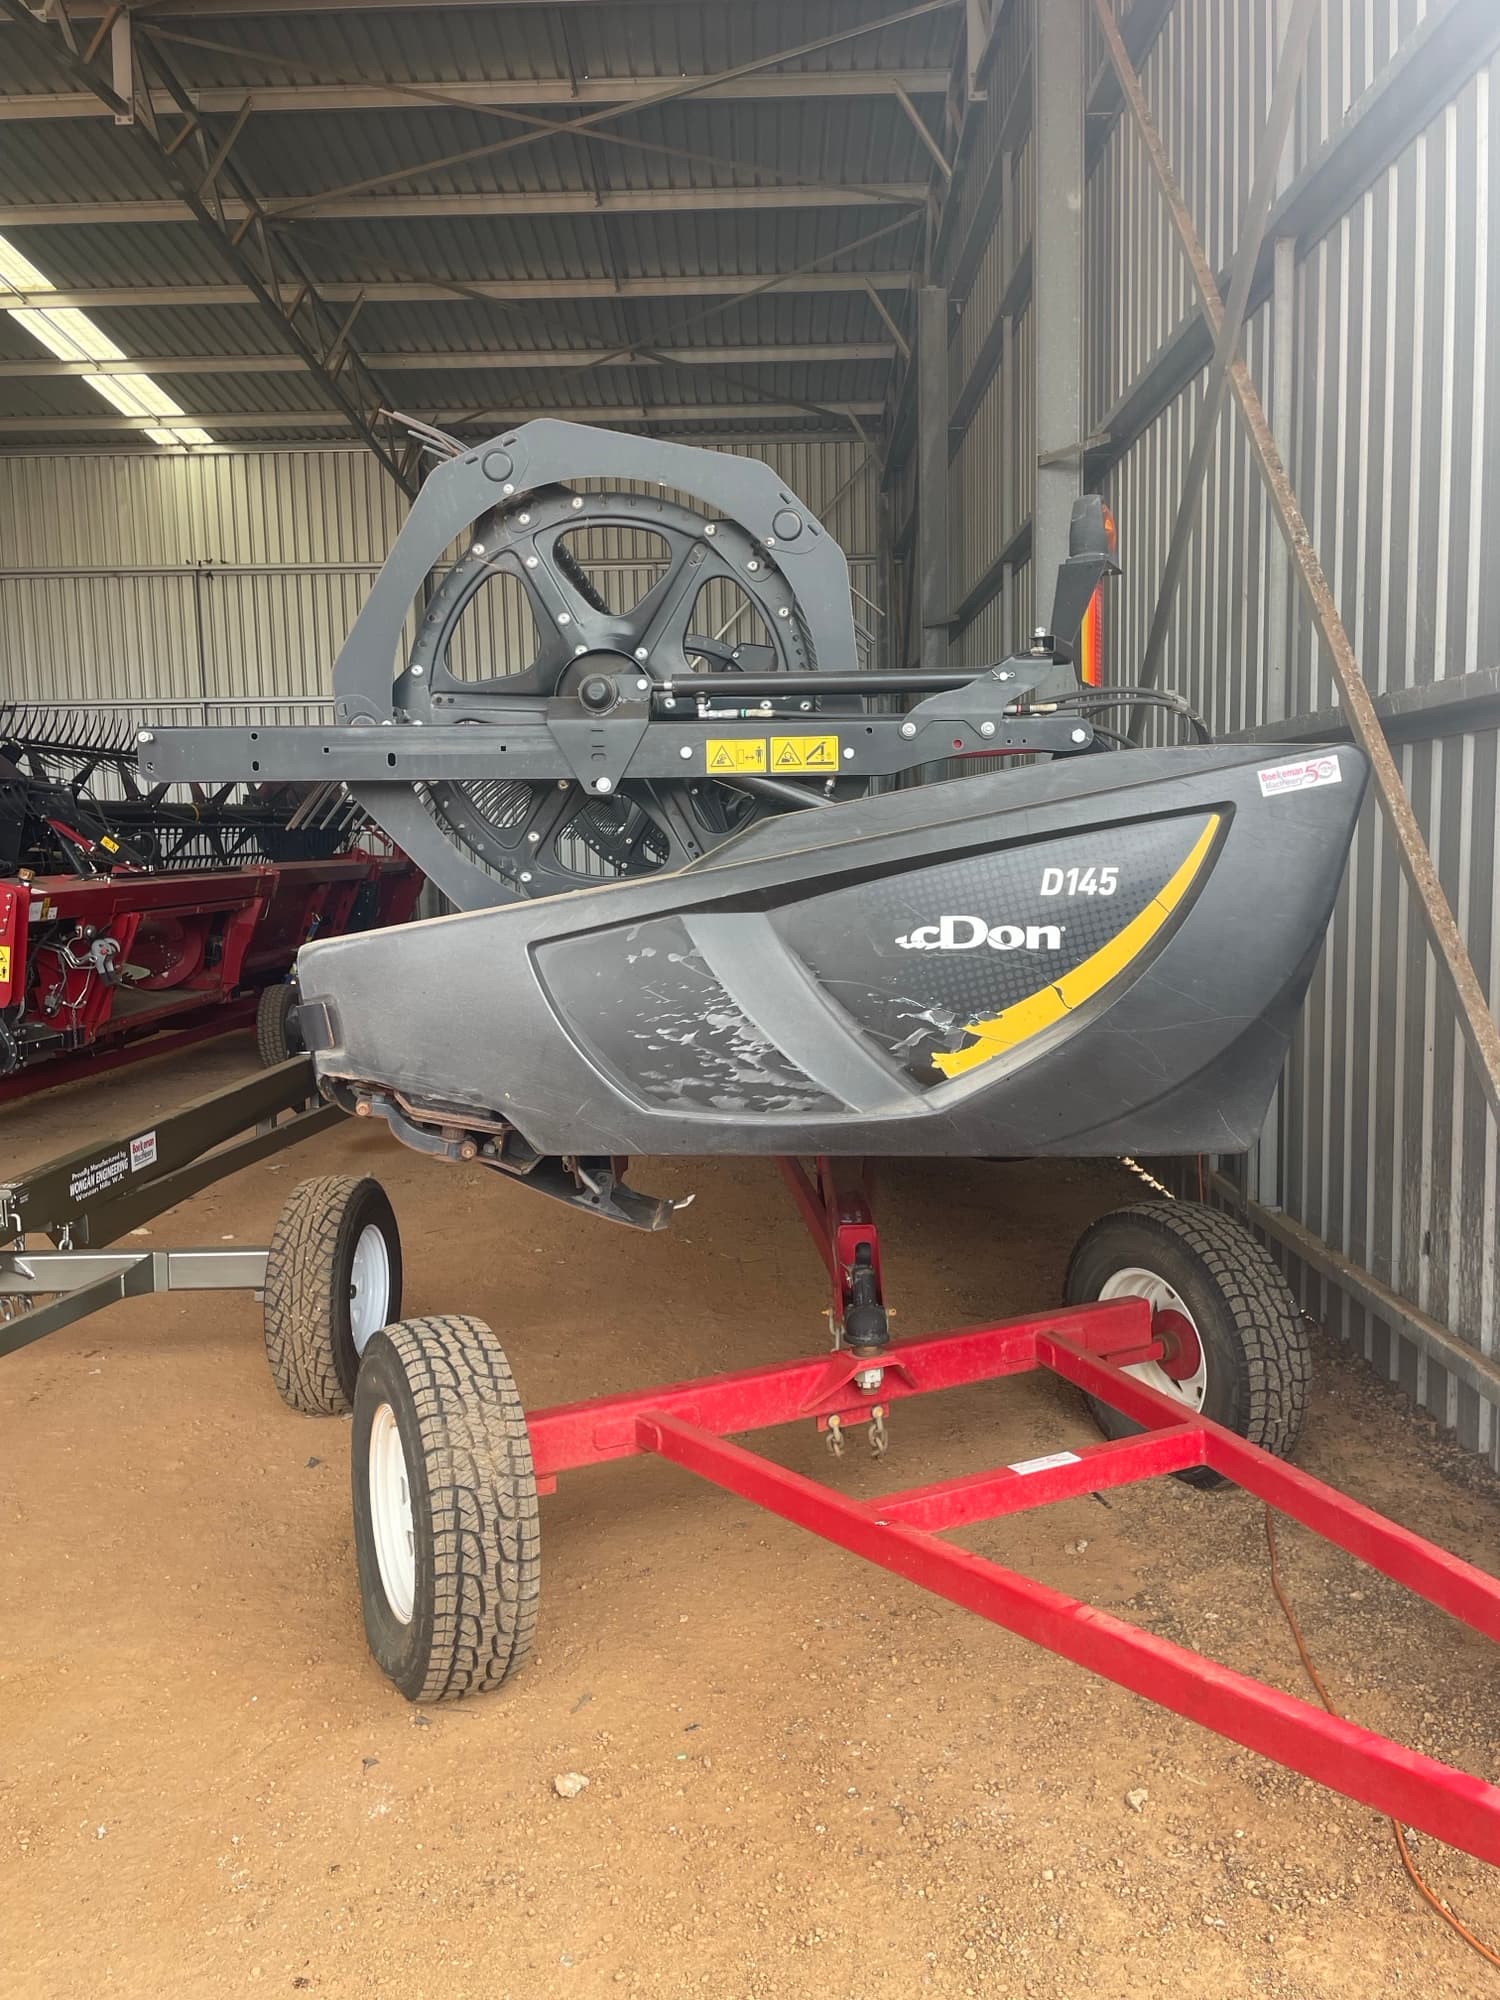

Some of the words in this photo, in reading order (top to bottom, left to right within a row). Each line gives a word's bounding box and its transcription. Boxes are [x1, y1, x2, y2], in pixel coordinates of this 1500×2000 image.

[1040, 867, 1119, 896] D145
[90, 1151, 120, 1171] Manufactured
[69, 1174, 95, 1197] WONGAN
[96, 1157, 129, 1184] ENGINEERING
